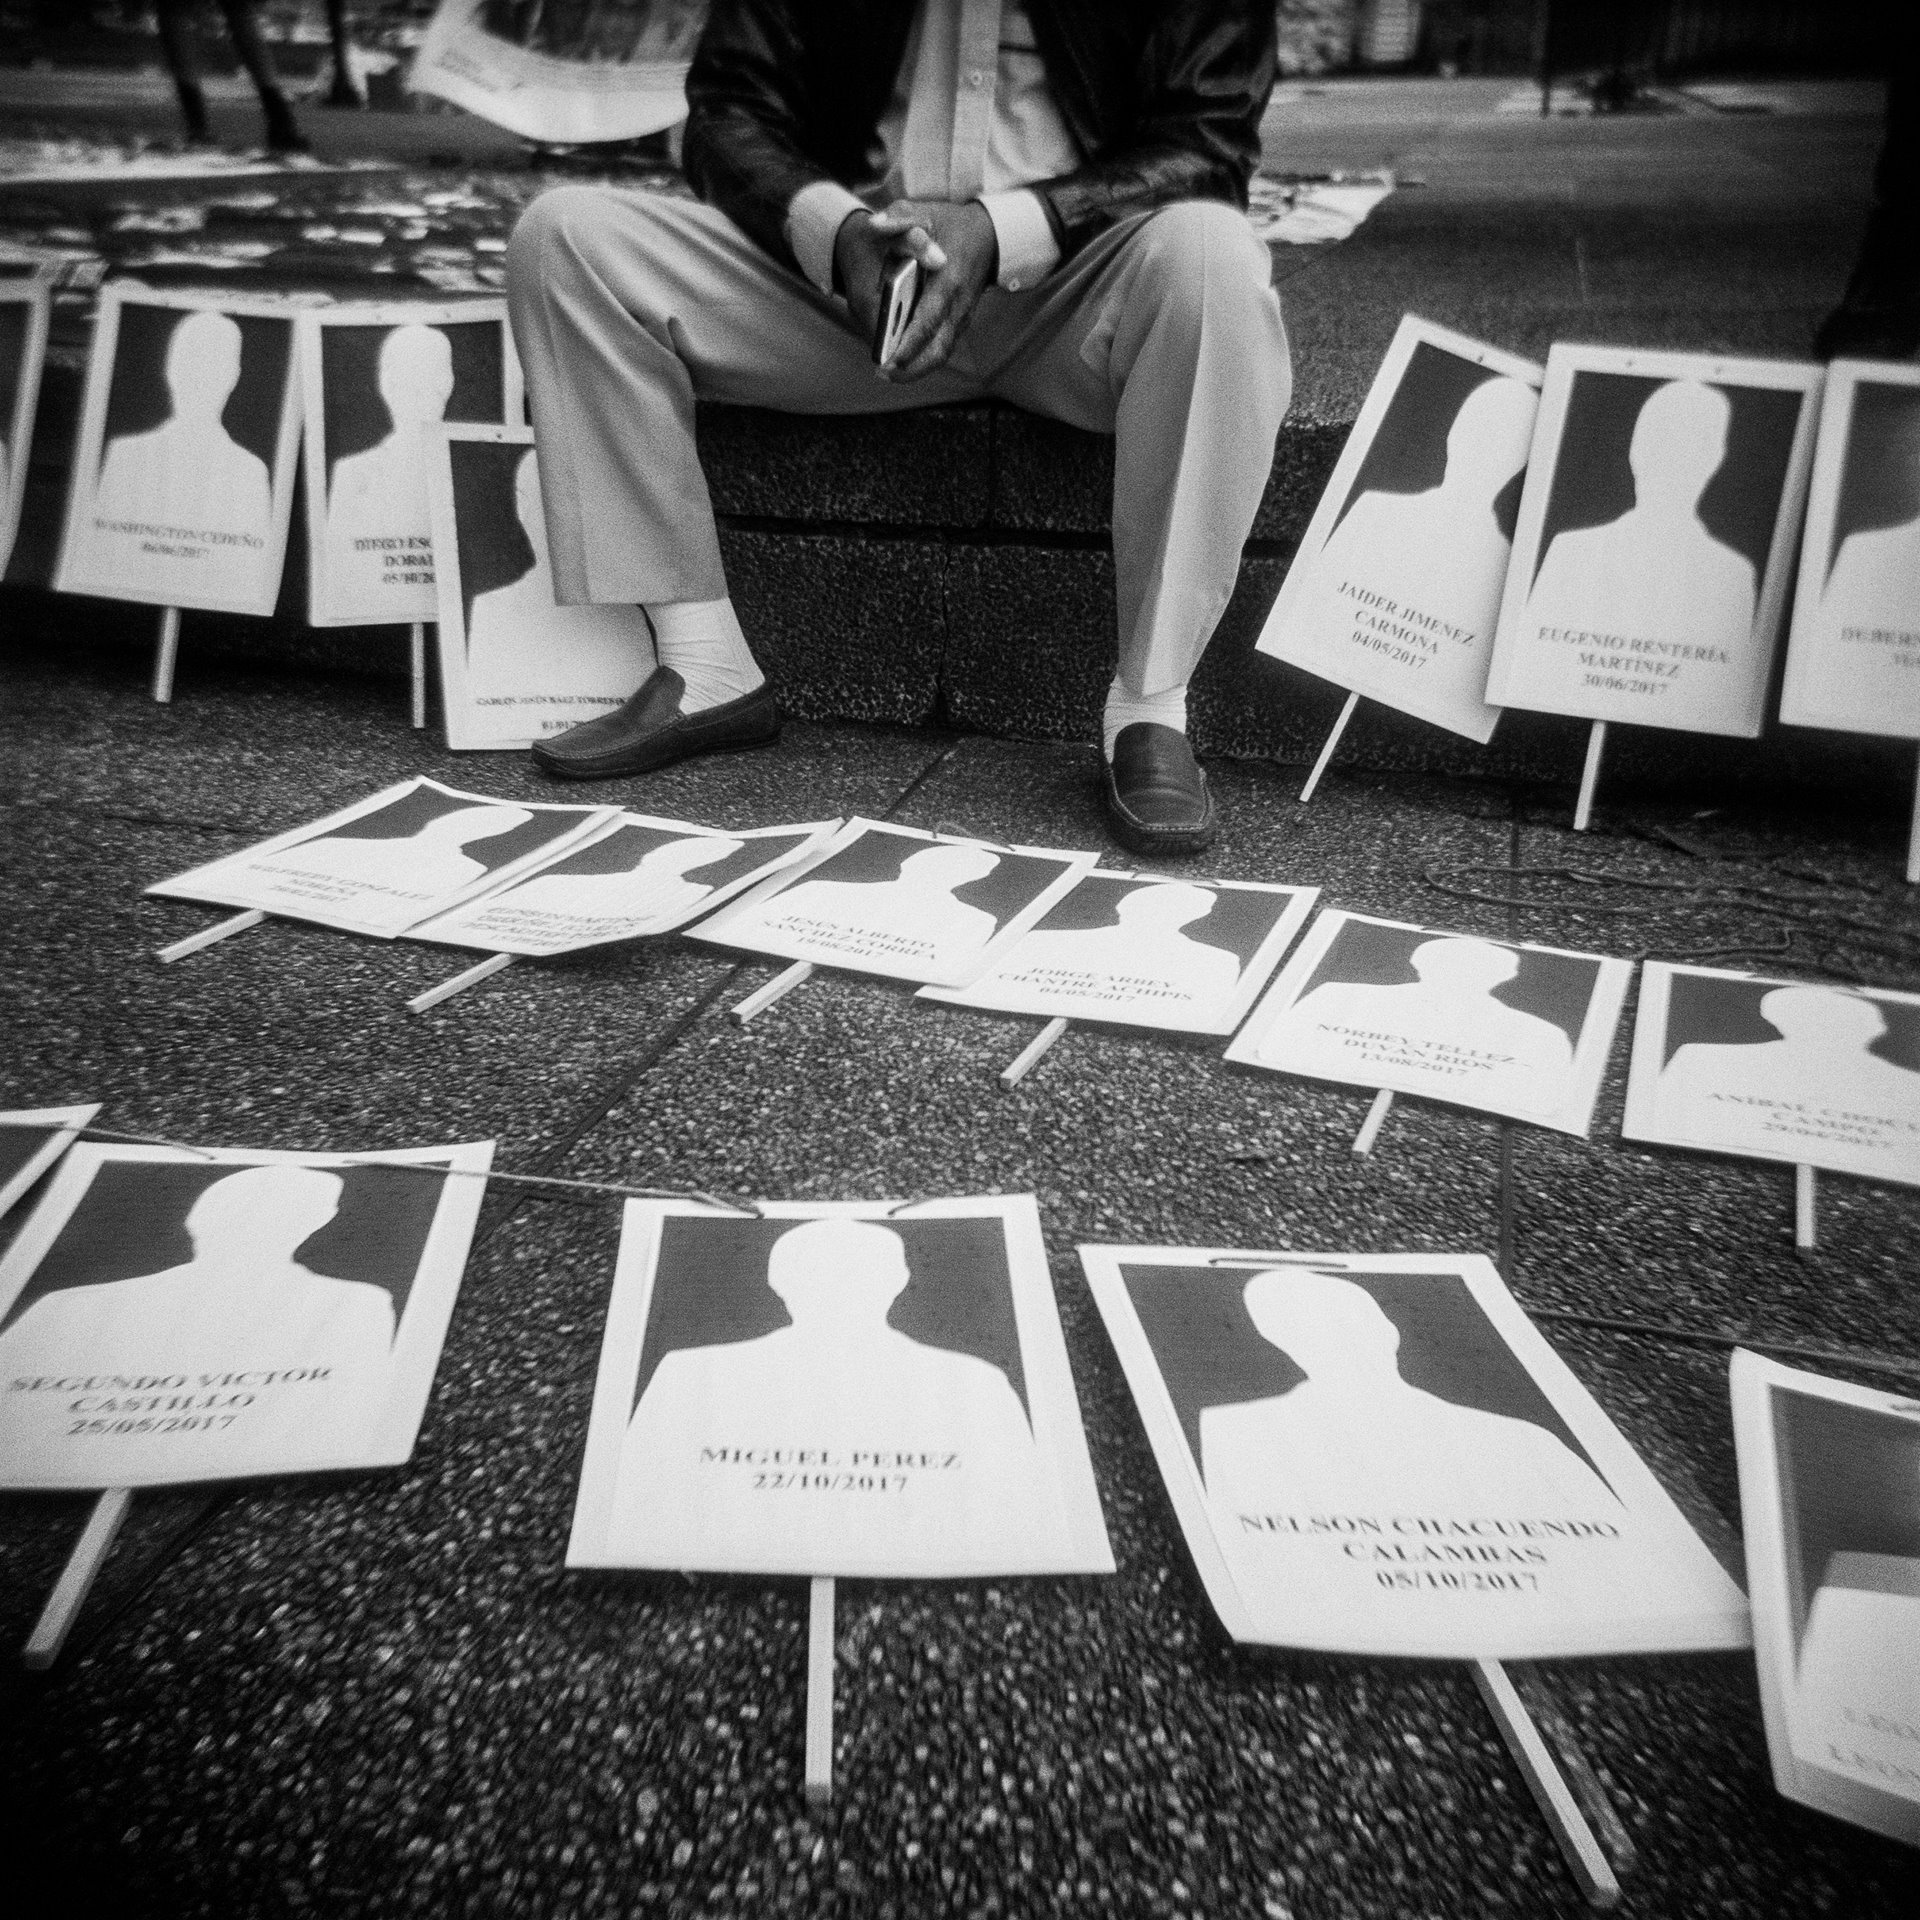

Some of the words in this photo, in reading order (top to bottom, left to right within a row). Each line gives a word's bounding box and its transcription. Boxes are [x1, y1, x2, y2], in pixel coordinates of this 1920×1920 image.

[354, 537, 404, 551] DIEGO
[1337, 582, 1398, 614] JAIDER
[1400, 608, 1476, 647] JIMENEZ
[1354, 610, 1438, 655] CARMONA
[1538, 626, 1625, 650] EUGENIO
[1352, 630, 1427, 670] 04/05/2017
[1582, 673, 1668, 695] 30/06/2017
[848, 927, 936, 949] ALBERTO
[1027, 967, 1094, 979] JORGE
[1318, 1023, 1408, 1045] NORBEY
[1422, 1040, 1516, 1064] TELLEZ
[1344, 1039, 1426, 1057] DUVAN
[1435, 1053, 1494, 1070] RIOS
[7, 1374, 188, 1392] SEGUNDO
[199, 1368, 332, 1387] VICTOR
[67, 1393, 257, 1413] CASTILLO
[700, 1447, 841, 1466] MIGUEL
[853, 1452, 962, 1469] PEREZ
[753, 1473, 908, 1492] 22/10/2017
[1238, 1513, 1382, 1536] NELSON
[1392, 1517, 1620, 1539] CHACUENDO
[1343, 1541, 1548, 1565] CALAMBAS
[1375, 1569, 1539, 1592] 05/10/2017
